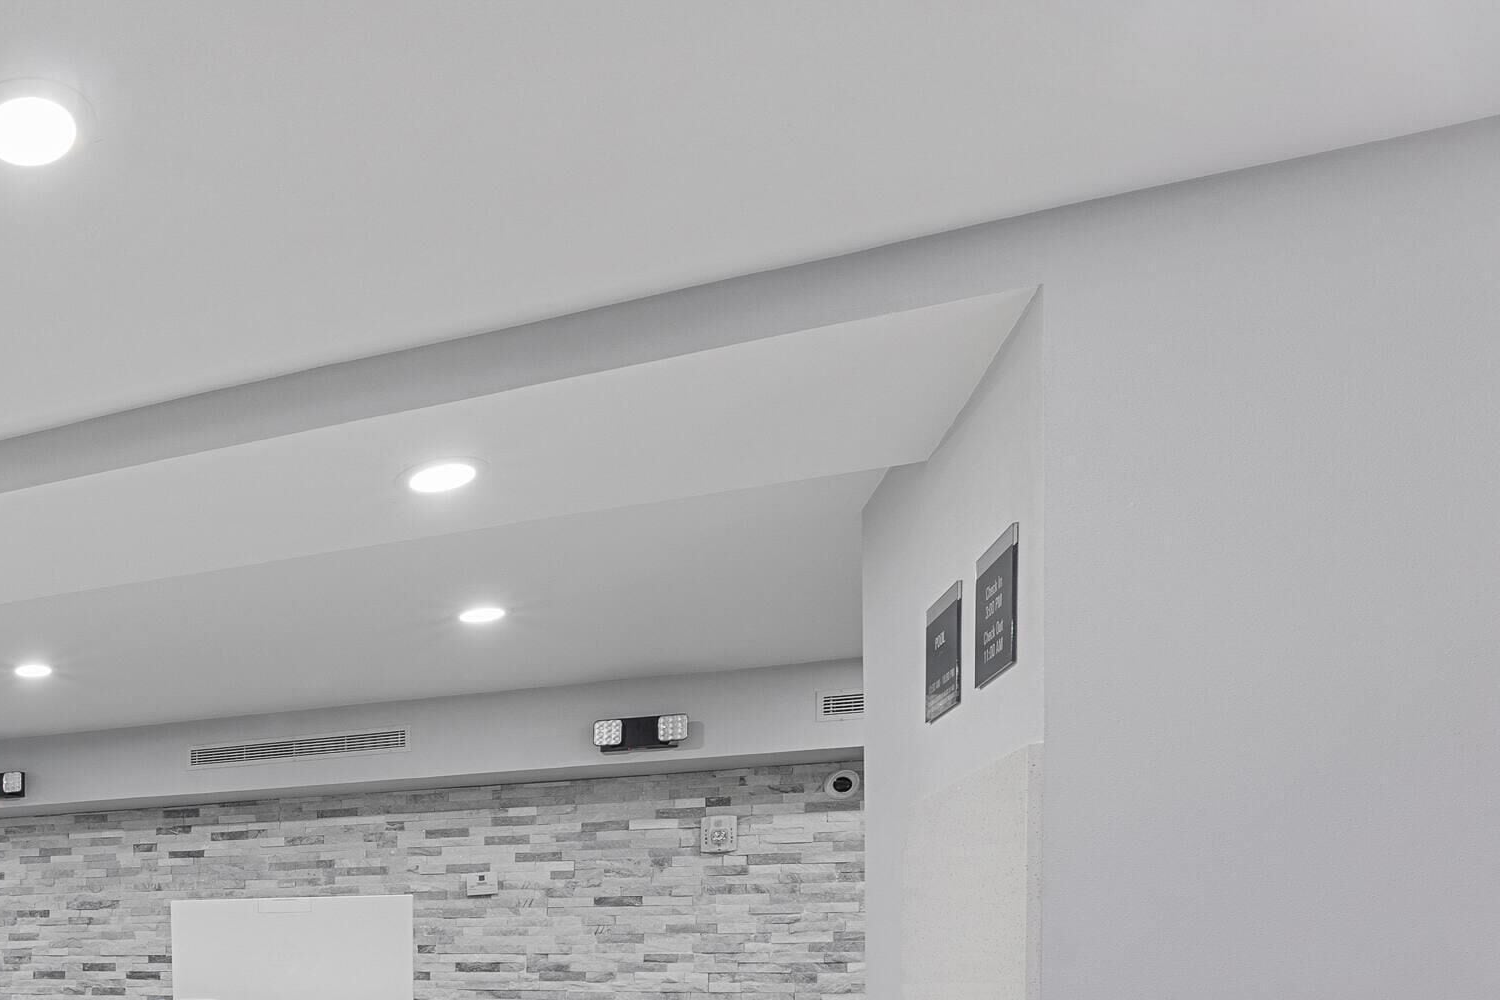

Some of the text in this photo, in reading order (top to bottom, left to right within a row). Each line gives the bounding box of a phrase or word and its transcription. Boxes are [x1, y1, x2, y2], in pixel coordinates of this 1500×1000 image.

[986, 580, 997, 600] Check
[934, 630, 946, 650] POOL
[984, 624, 995, 645] Check
